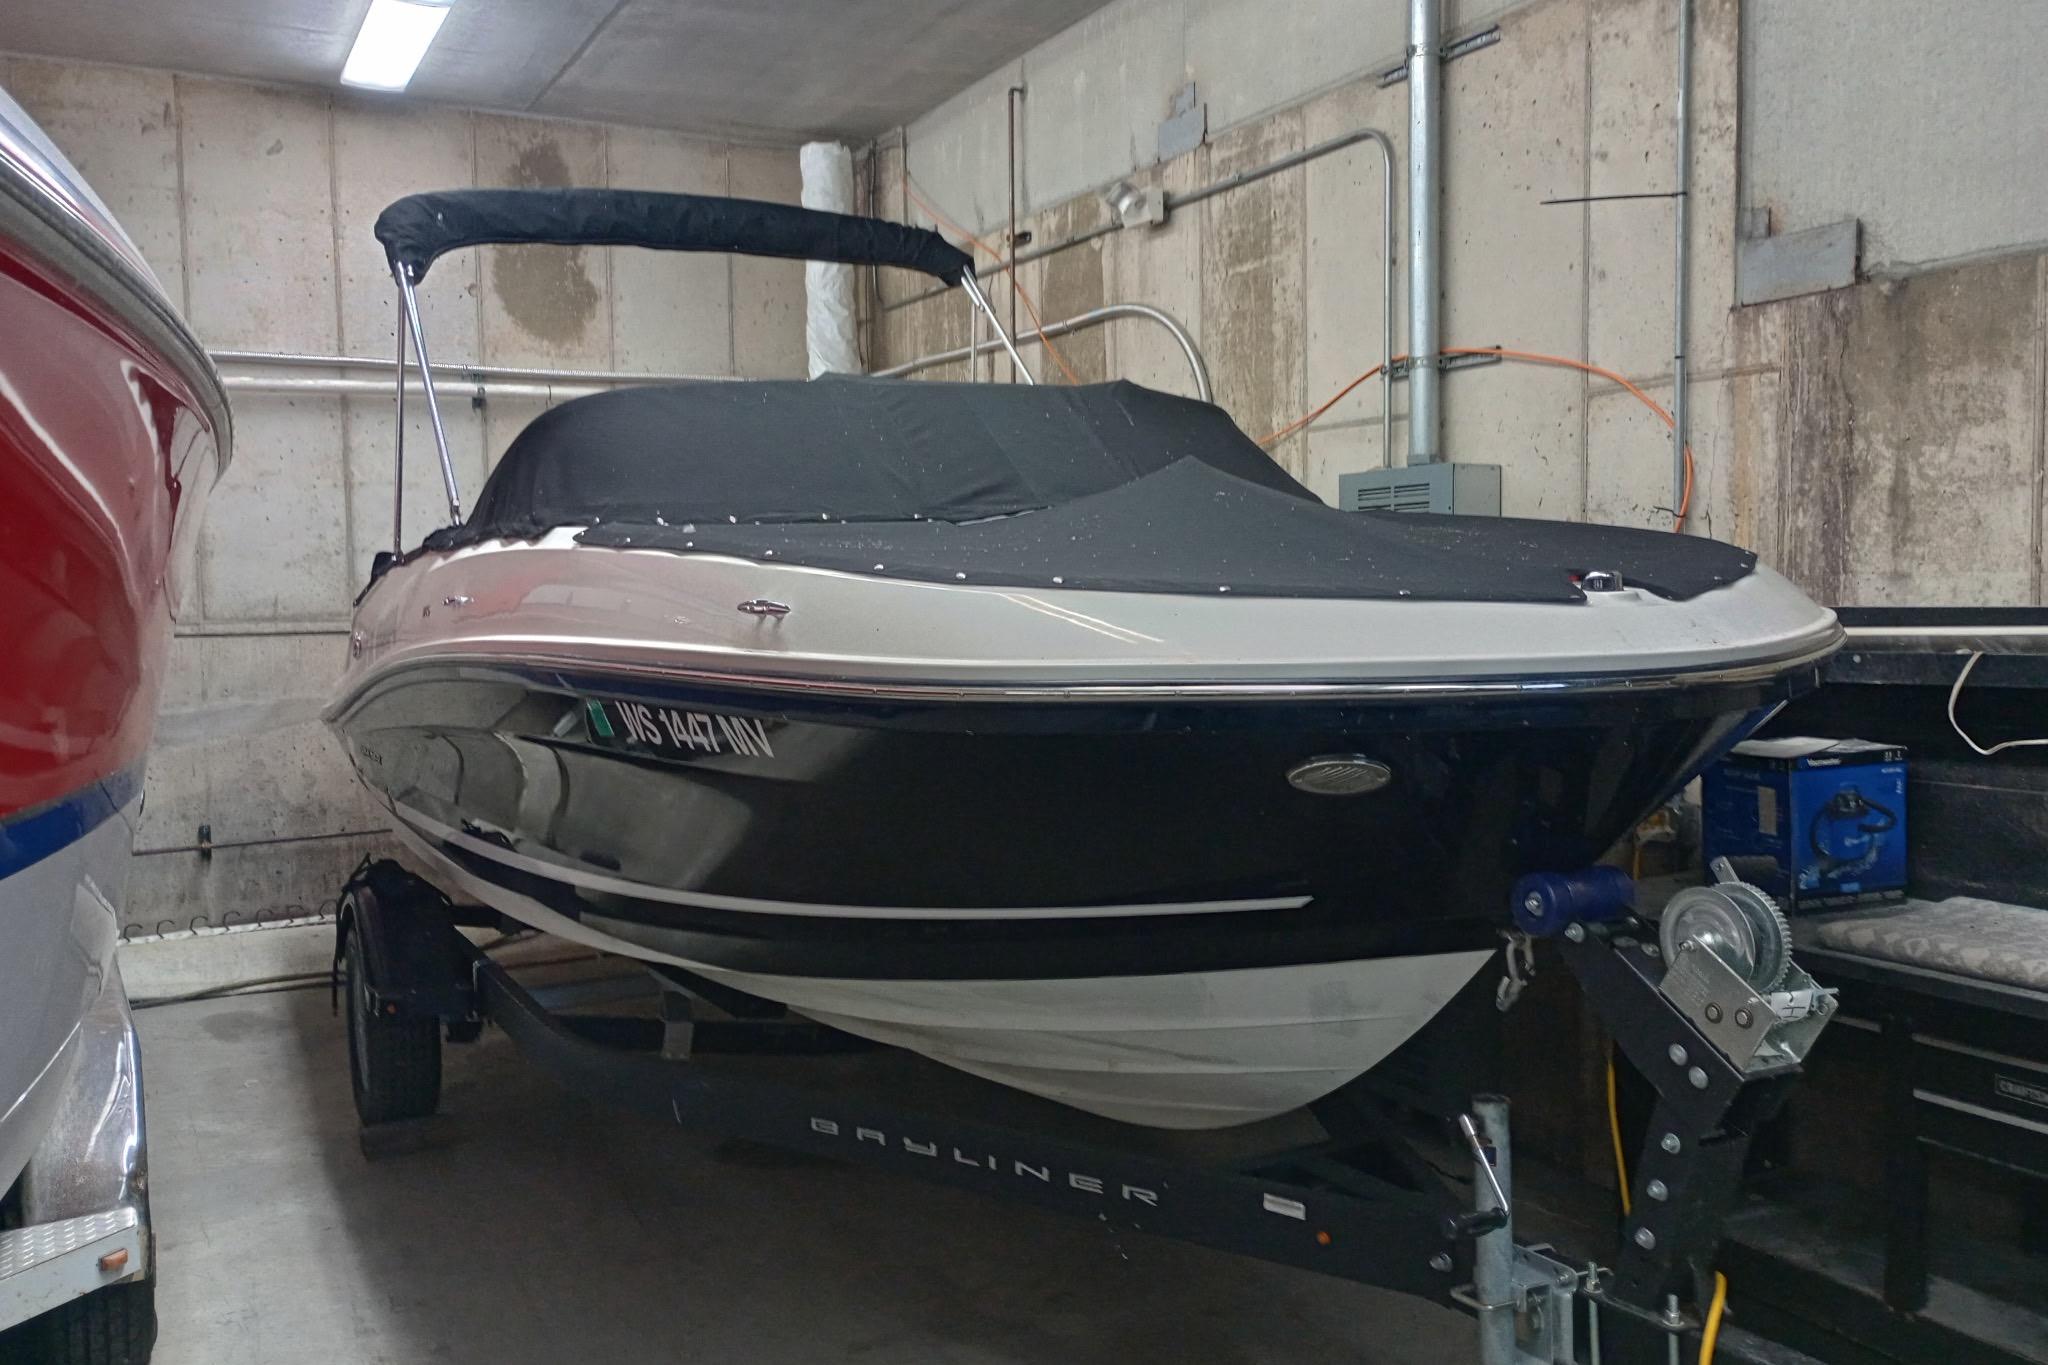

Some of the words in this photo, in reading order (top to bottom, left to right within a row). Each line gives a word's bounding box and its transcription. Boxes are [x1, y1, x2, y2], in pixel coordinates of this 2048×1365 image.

[615, 701, 662, 744] WS
[657, 708, 720, 752] 1447
[715, 713, 774, 757] MV
[811, 1117, 1158, 1207] BAYLINER
